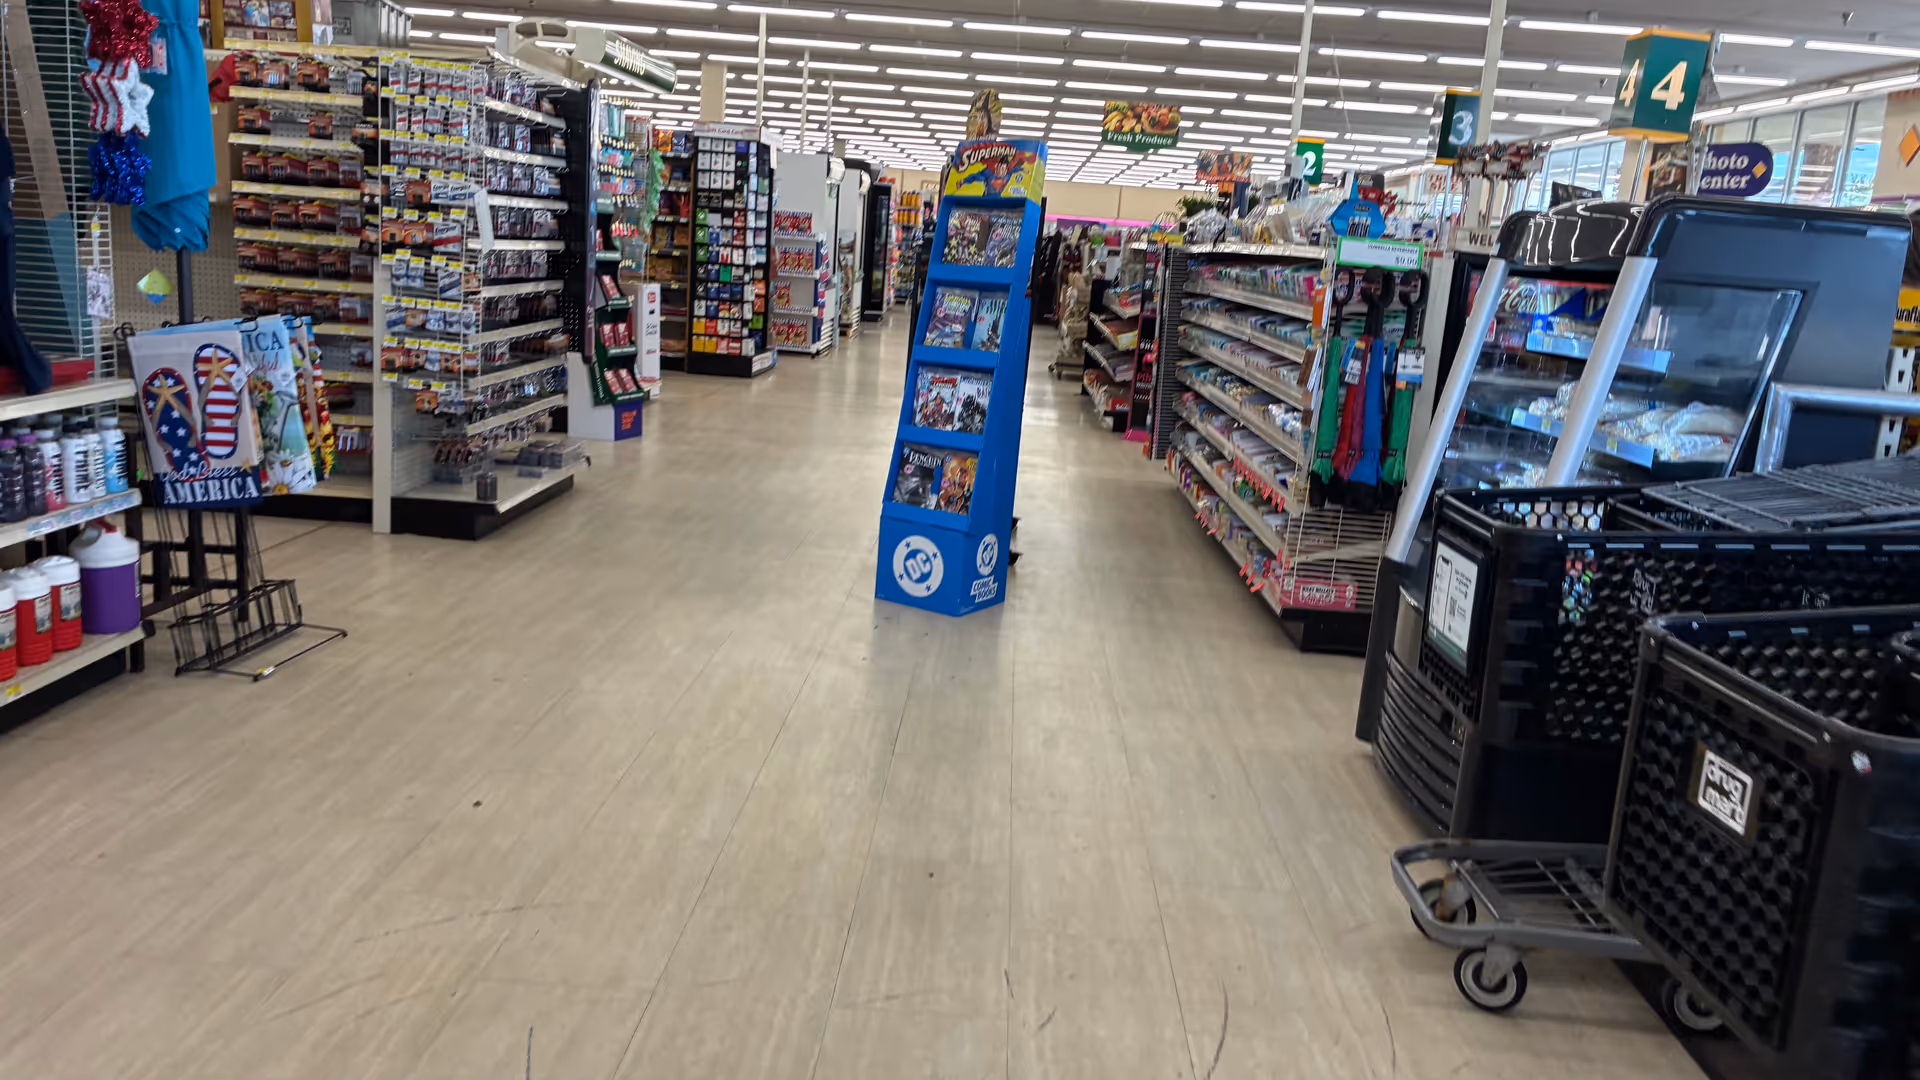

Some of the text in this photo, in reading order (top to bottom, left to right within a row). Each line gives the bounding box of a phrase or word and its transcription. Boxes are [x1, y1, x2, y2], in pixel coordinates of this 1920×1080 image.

[613, 39, 647, 76] SHAVING
[1618, 58, 1640, 109] 4
[1650, 60, 1688, 111] 4
[1107, 131, 1174, 146] Fresh Produce
[1448, 109, 1474, 146] 3
[957, 145, 1018, 172] SUPERMAN
[1302, 150, 1317, 177] 2
[1703, 150, 1750, 171] hoto
[1700, 171, 1752, 190] enter
[73, 450, 89, 492] PRIME
[163, 475, 260, 504] AMERICA
[904, 552, 932, 581] DC
[983, 544, 994, 565] DC
[1706, 761, 1744, 802] drug
